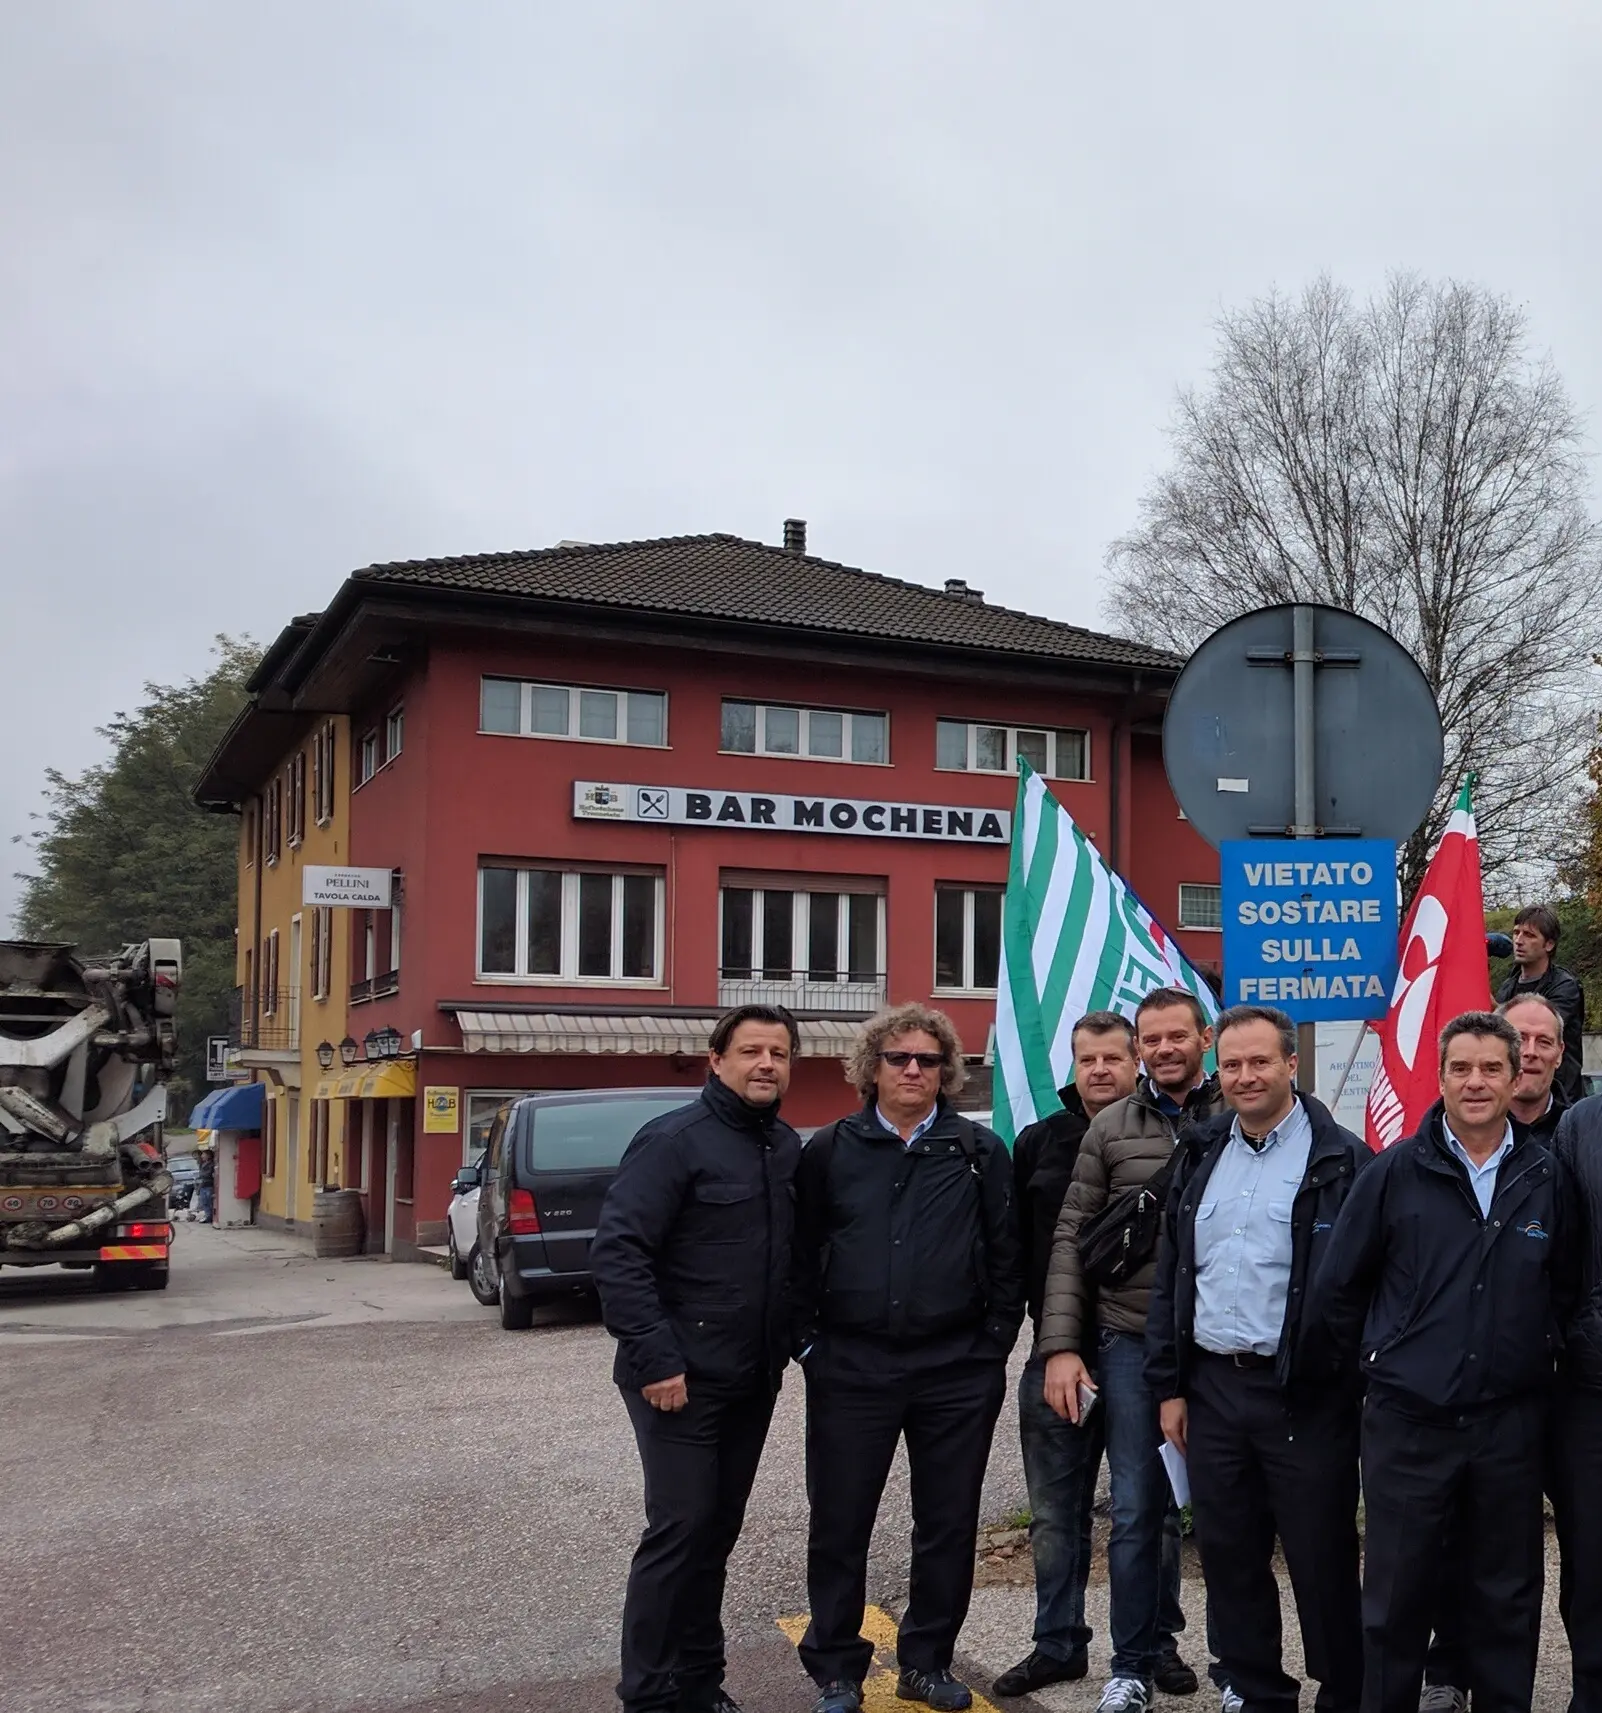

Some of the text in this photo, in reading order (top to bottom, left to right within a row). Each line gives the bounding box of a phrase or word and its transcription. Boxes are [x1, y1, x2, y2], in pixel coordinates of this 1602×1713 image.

[685, 793, 1004, 839] BAR MOCHENA
[325, 877, 370, 889] PELLINI
[1243, 862, 1374, 887] VIETATO
[313, 892, 381, 902] TAVOLA CALDA
[1238, 899, 1382, 925] SOSTARE
[1261, 937, 1362, 963] SULLA
[1239, 974, 1386, 1002] FERMATA
